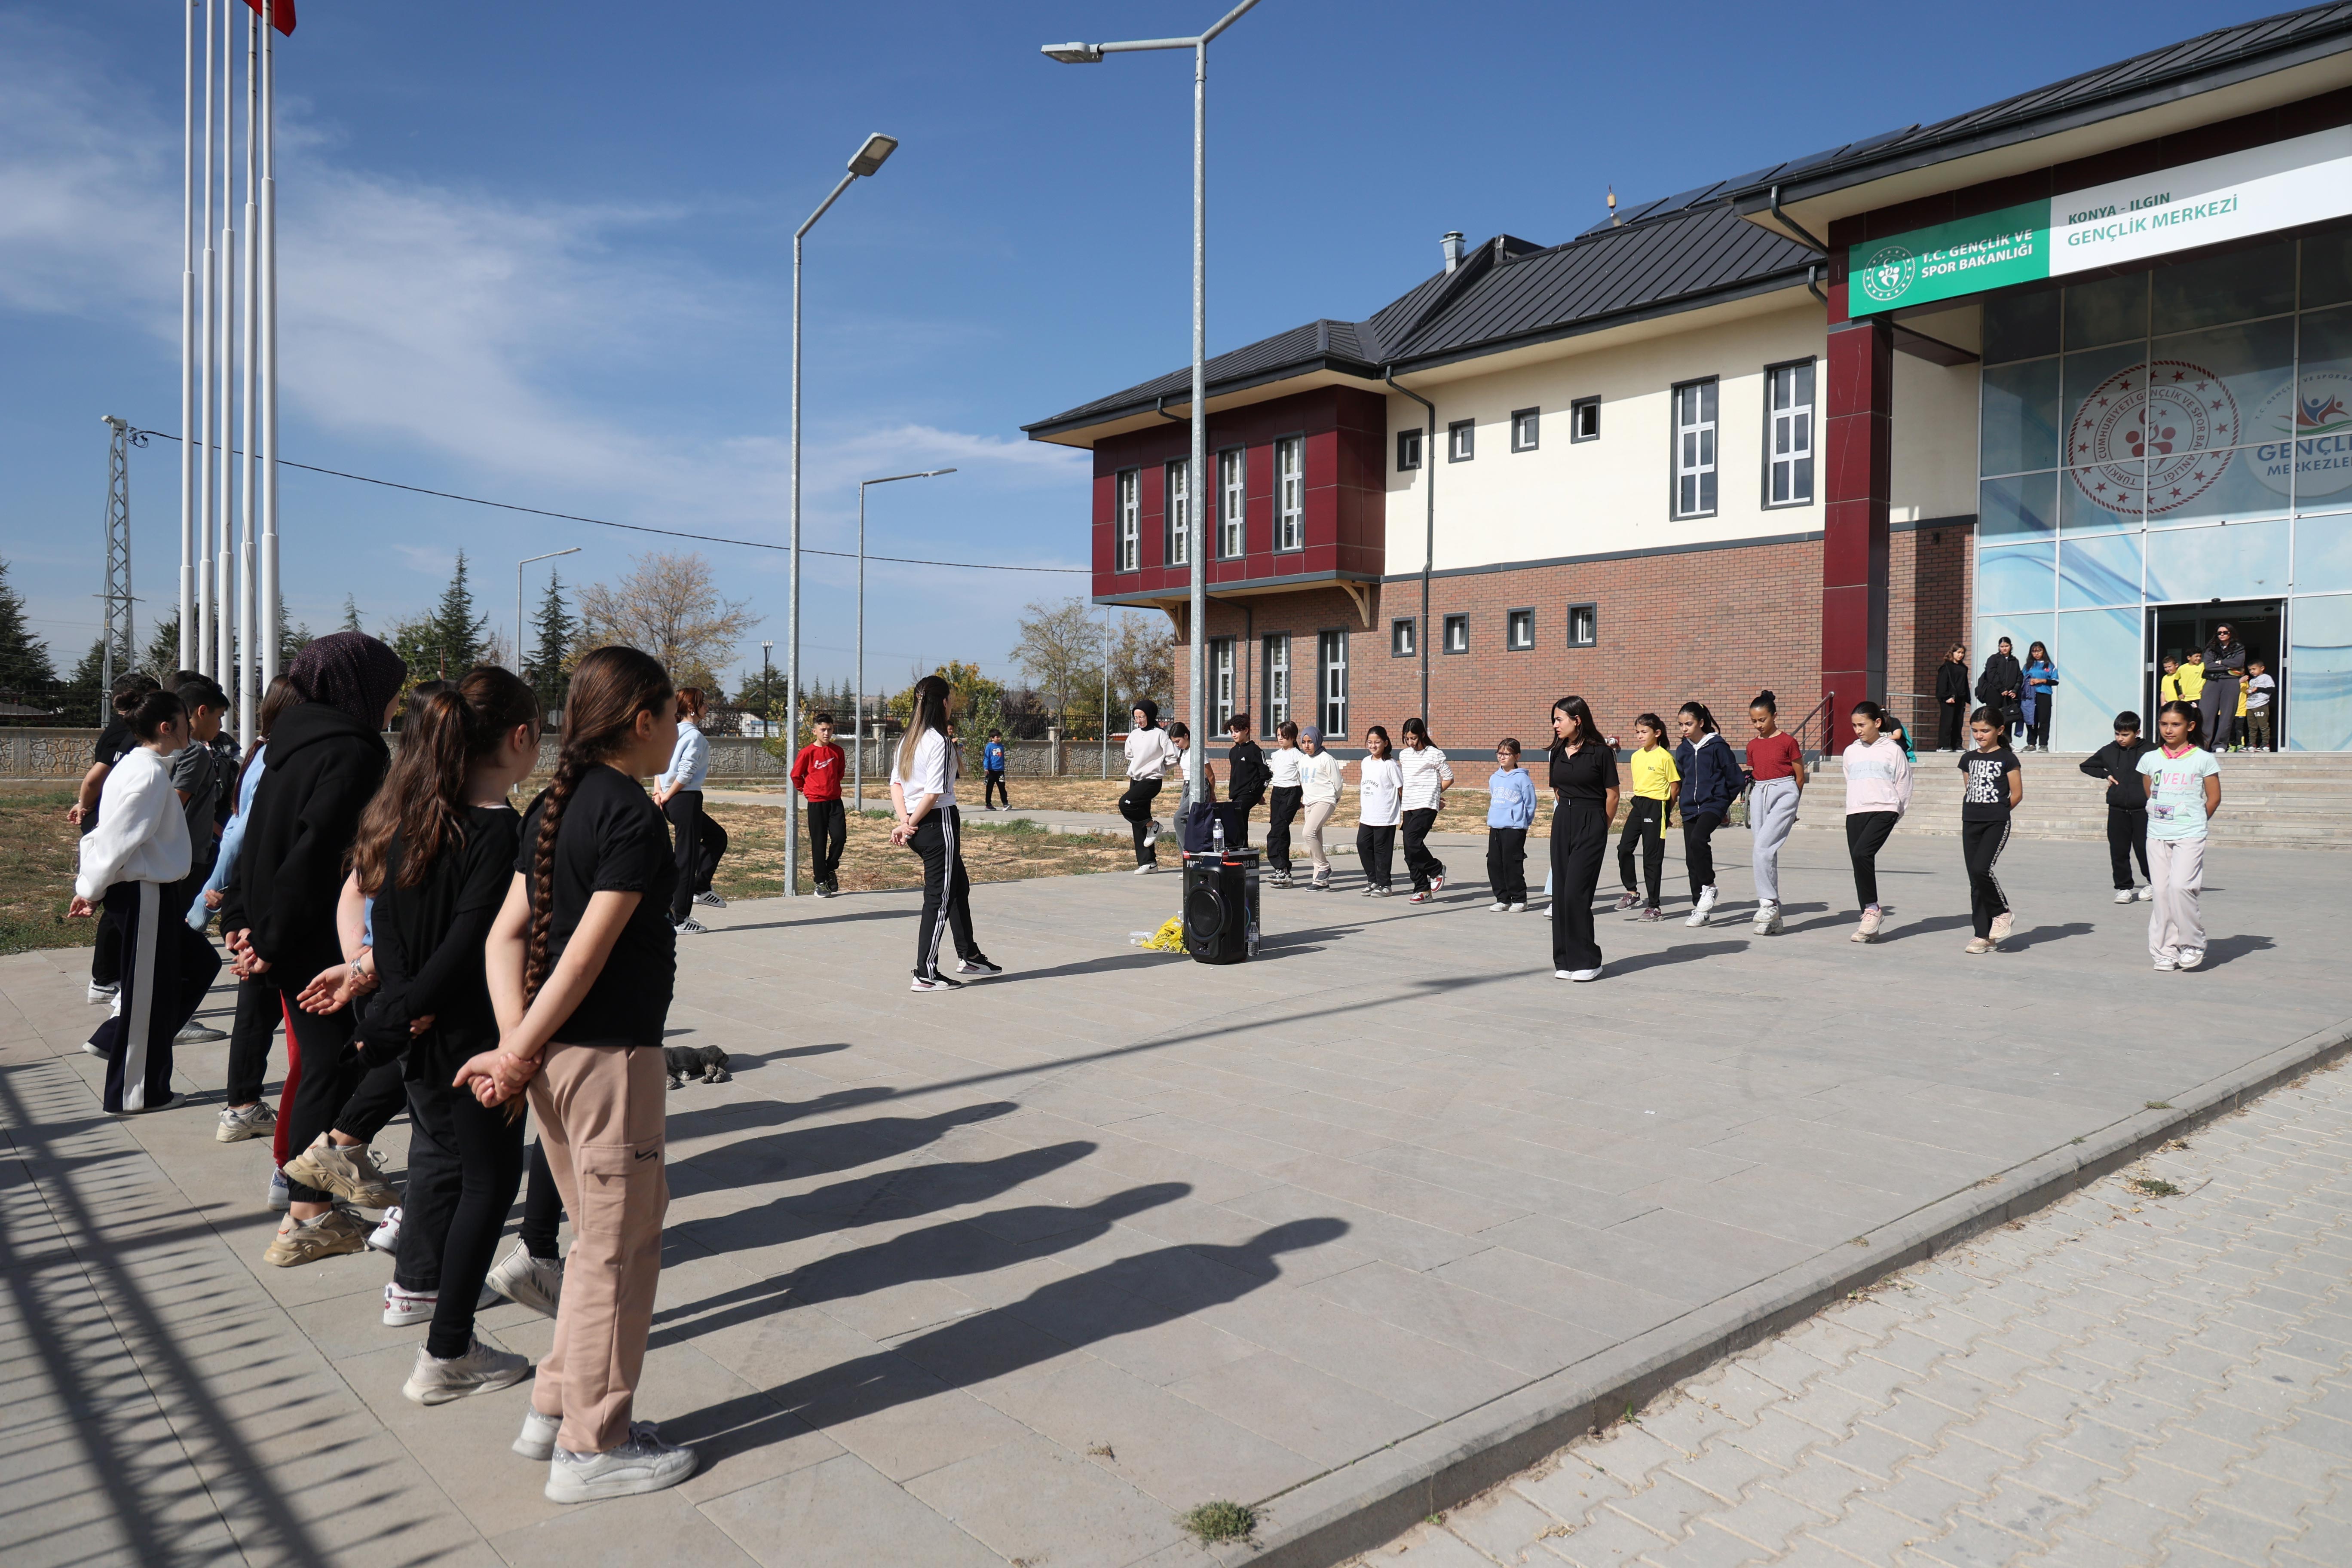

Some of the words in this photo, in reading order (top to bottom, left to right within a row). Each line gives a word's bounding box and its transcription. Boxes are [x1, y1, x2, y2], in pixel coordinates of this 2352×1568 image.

[2067, 217, 2147, 246] GENÇLİK
[2152, 194, 2238, 229] MERKEZİ
[2068, 205, 2116, 225] KONYA
[2130, 192, 2170, 211] ILGIN
[1921, 261, 1956, 278] SPOR
[1959, 243, 2033, 270] BAKANLIĞI
[1922, 249, 1946, 263] T.C.
[1949, 234, 2010, 257] GENÇLİK
[2014, 229, 2033, 242] VE
[2136, 389, 2182, 401] GNÇLİK
[2181, 396, 2195, 409] VE
[2098, 396, 2134, 459] CUMHURİYETİ
[2191, 407, 2205, 432] SPOR
[2104, 460, 2135, 485] TÜRKİY
[2163, 435, 2205, 482] BAANLIĞI
[1968, 760, 2003, 777] VIBES
[1966, 788, 1999, 803] VIBES
